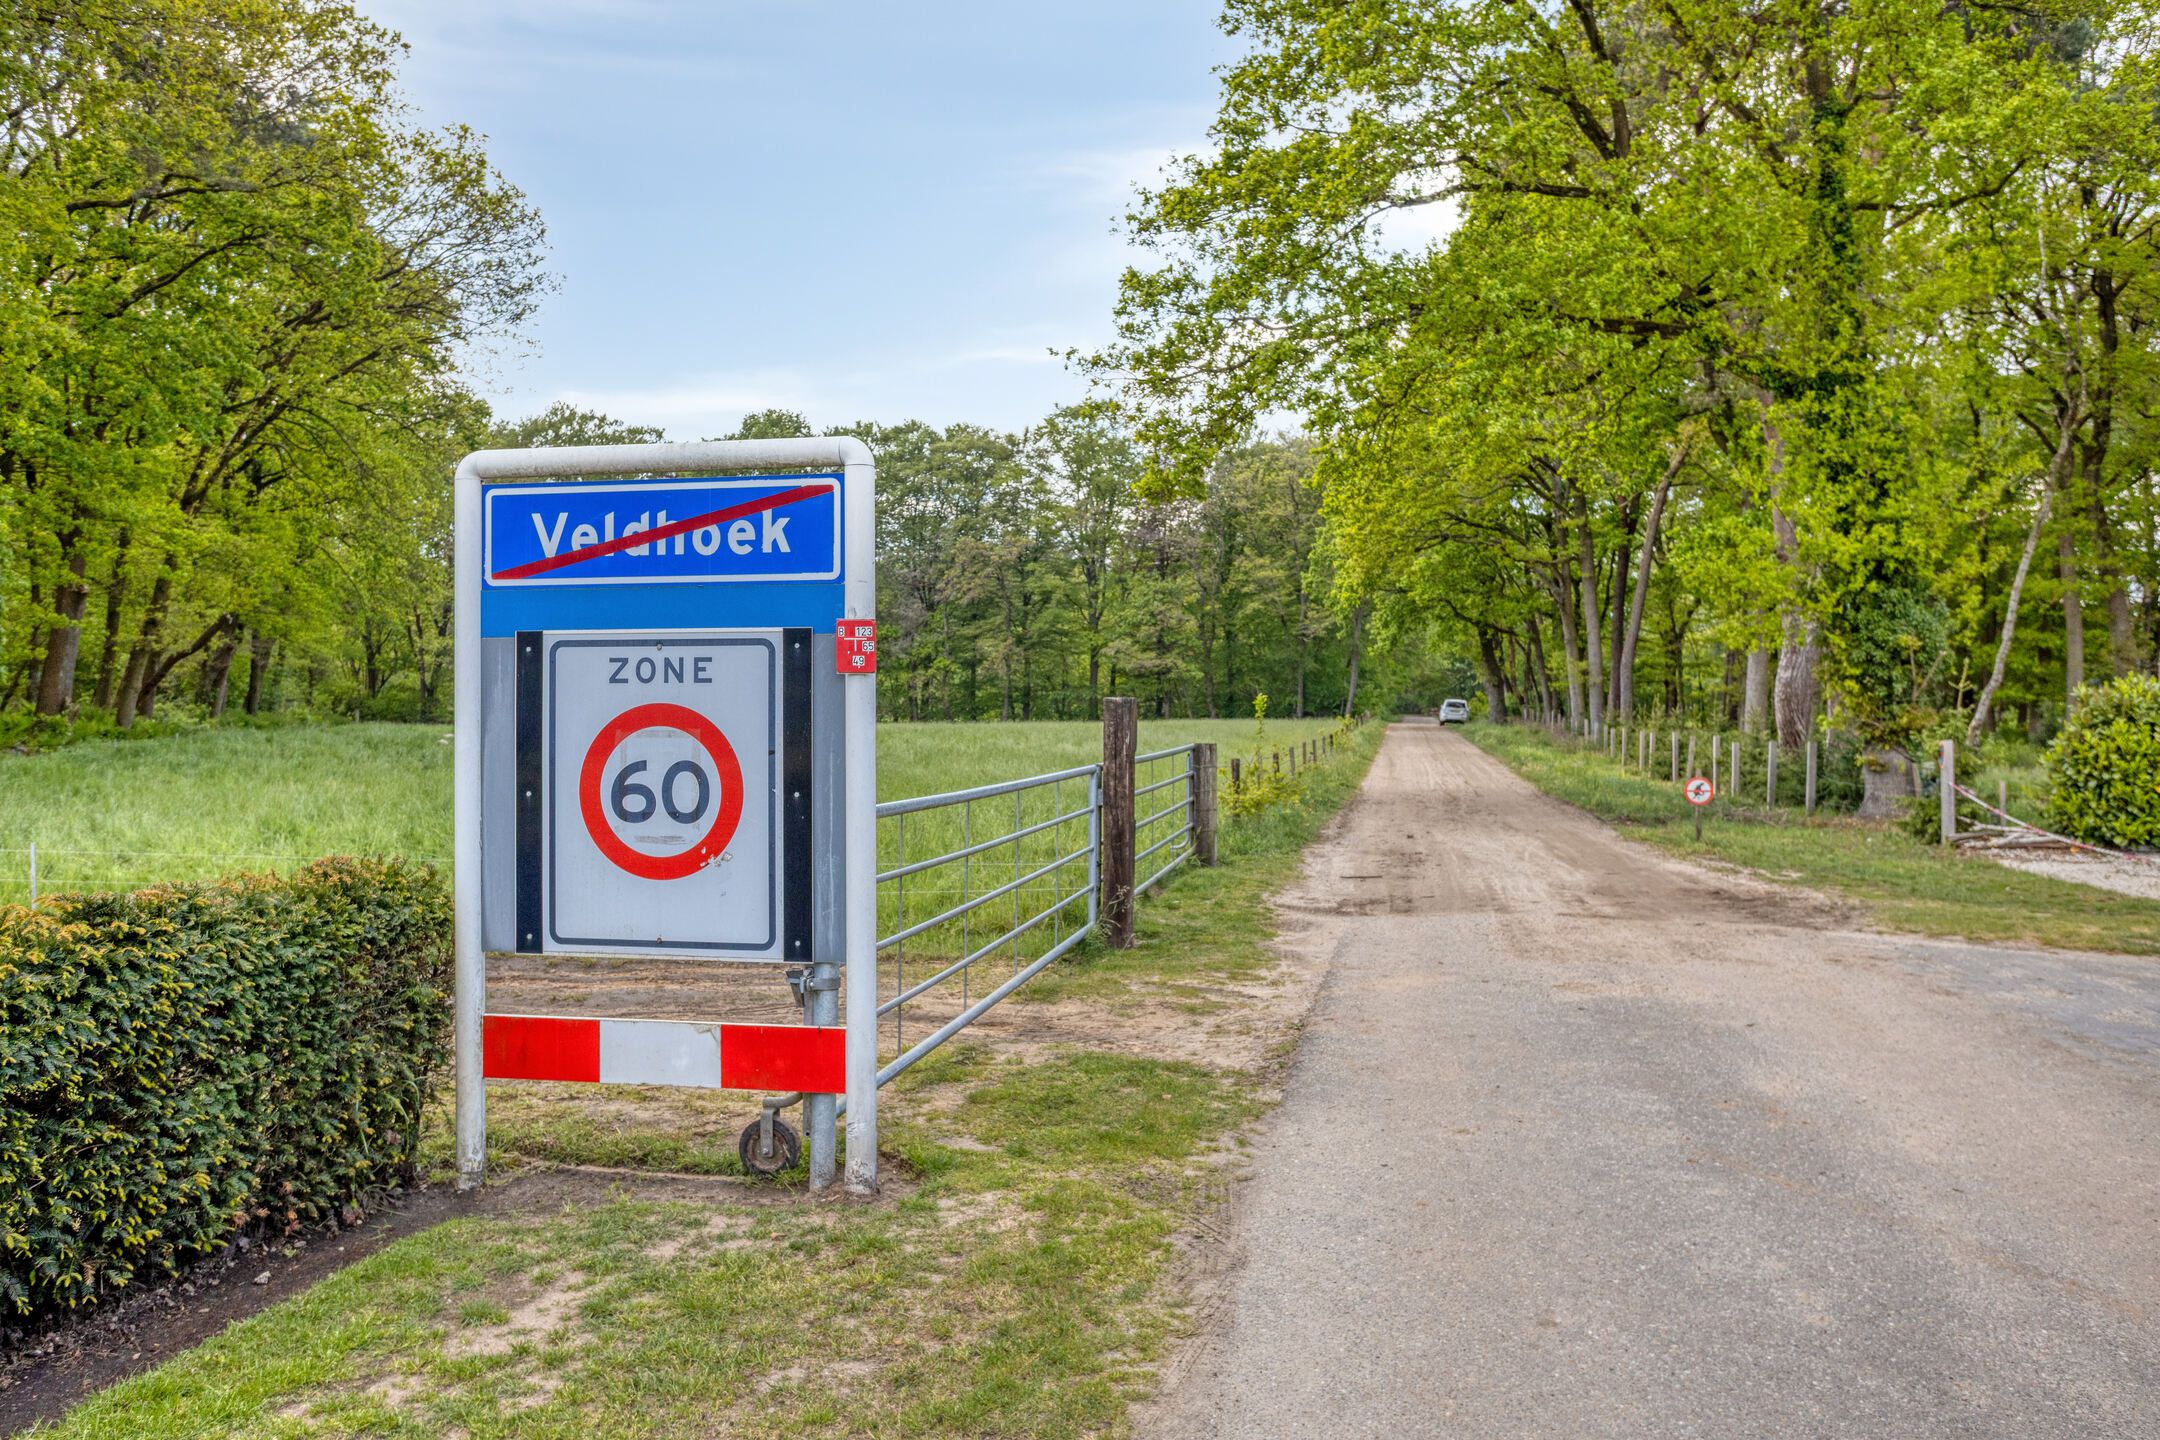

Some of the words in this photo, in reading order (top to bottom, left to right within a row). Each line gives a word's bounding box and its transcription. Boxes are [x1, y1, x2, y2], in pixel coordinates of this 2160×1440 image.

[531, 508, 791, 558] Veldhoek
[856, 627, 872, 636] 123
[862, 641, 874, 651] 65
[608, 656, 713, 684] ZONE
[853, 656, 864, 665] 49
[610, 759, 710, 825] 60
